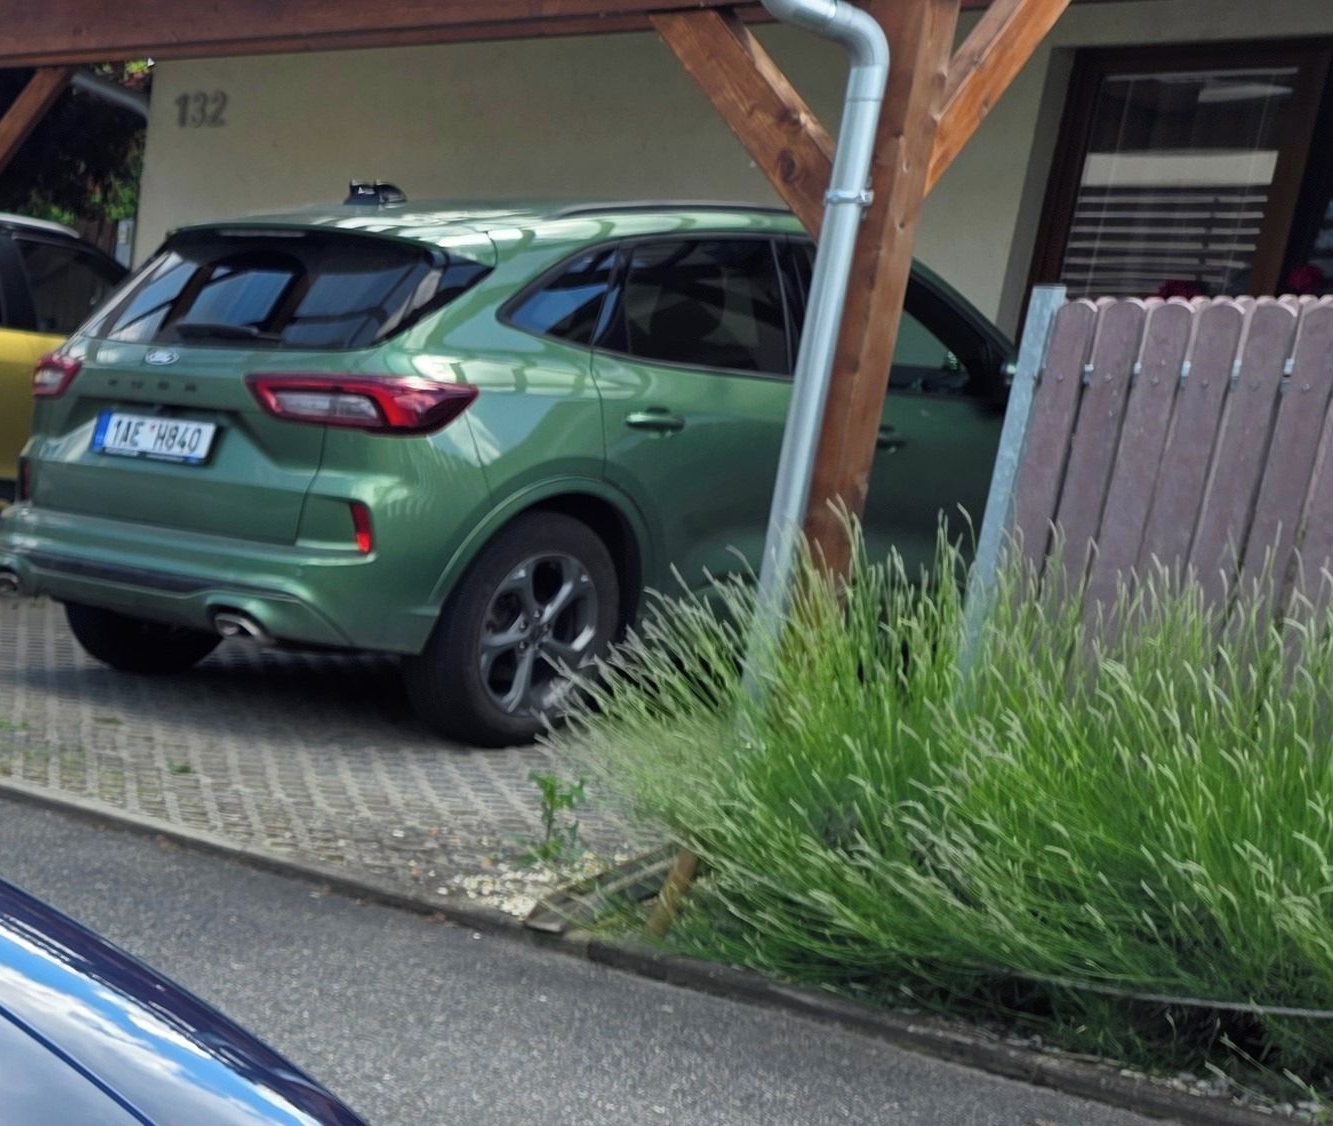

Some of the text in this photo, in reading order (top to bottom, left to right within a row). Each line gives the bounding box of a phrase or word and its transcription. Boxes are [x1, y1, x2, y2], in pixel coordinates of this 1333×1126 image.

[174, 89, 228, 129] 132
[113, 419, 202, 453] 1AE H840
